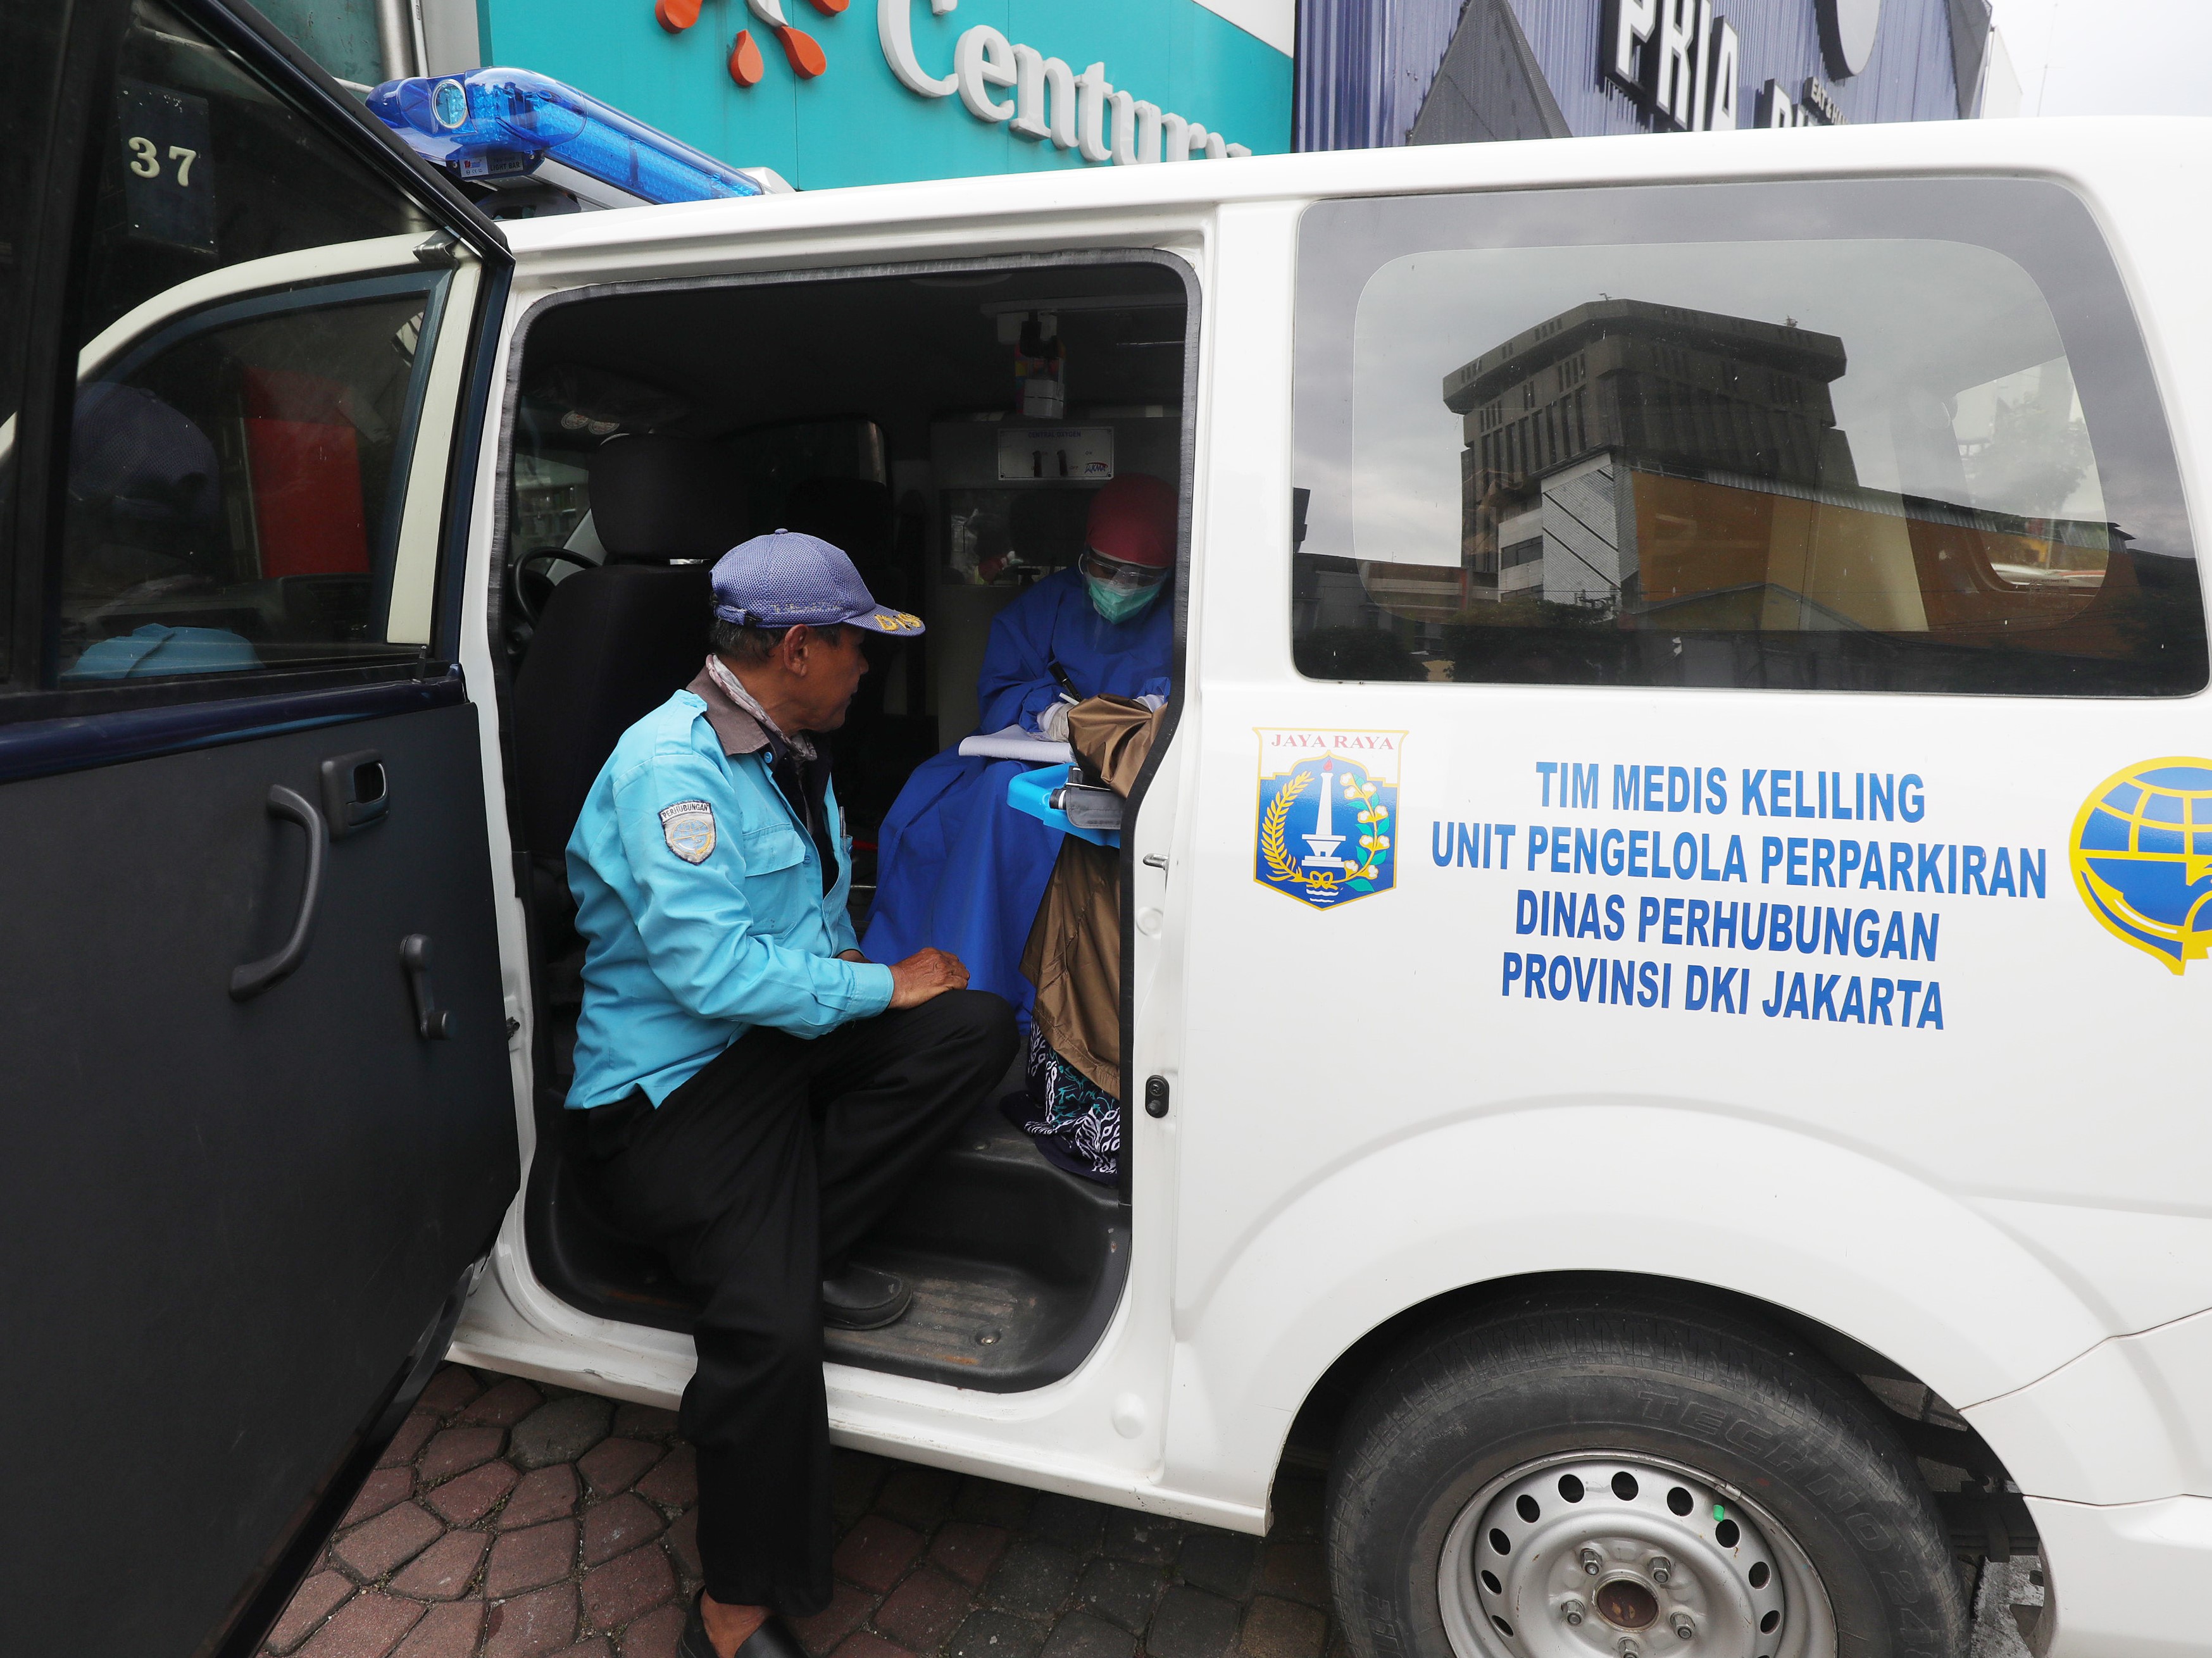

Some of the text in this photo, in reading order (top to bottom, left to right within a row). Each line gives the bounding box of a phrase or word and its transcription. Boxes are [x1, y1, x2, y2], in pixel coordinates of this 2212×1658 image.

[878, 0, 1251, 163] Centur
[1616, 0, 1739, 132] PRIA
[1811, 77, 1828, 111] EAT
[128, 137, 197, 187] 37
[1272, 734, 1395, 750] JAYA RAYA
[1537, 762, 1925, 823] TIM MEDIS KELILING
[1432, 821, 2047, 899] UNIT PENGELOLA PERPARKIRAN
[1516, 889, 1940, 961] DINAS PERHUBUNGAN
[1502, 952, 1944, 1030] PROVINSI DKI JAKARTA
